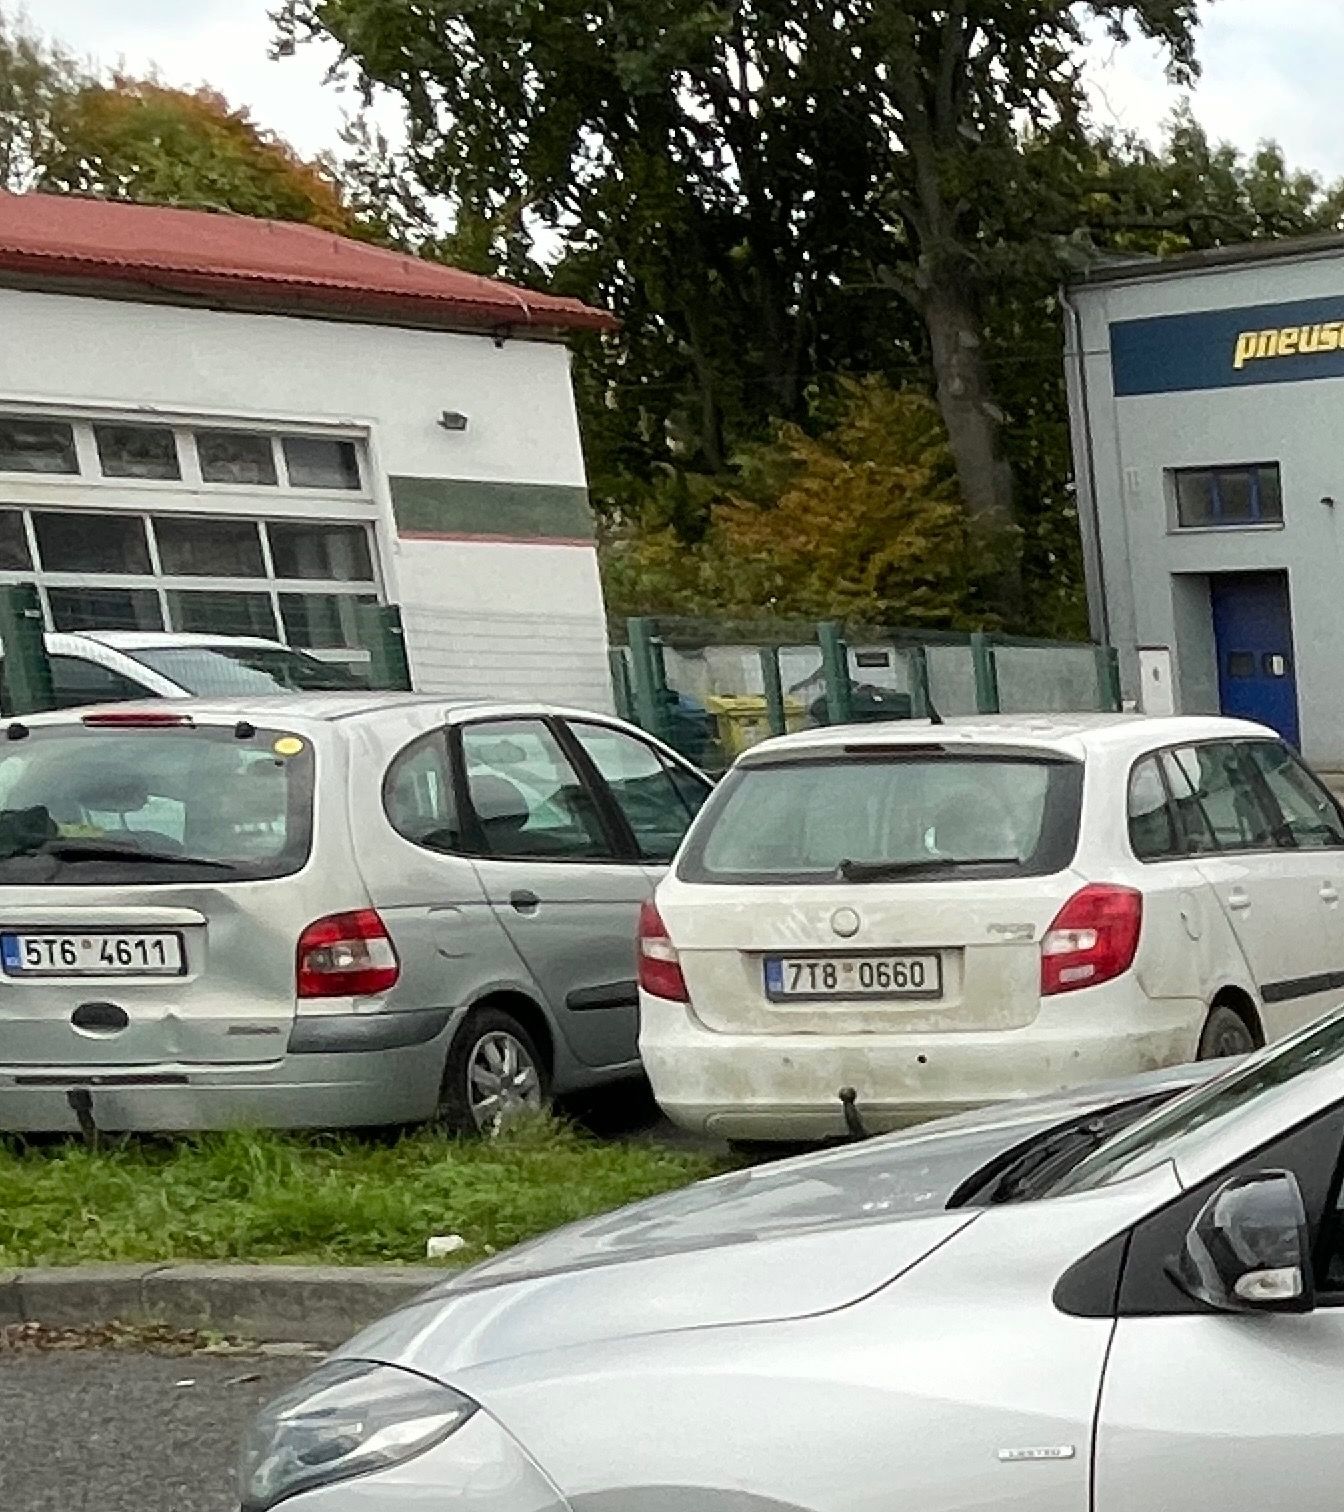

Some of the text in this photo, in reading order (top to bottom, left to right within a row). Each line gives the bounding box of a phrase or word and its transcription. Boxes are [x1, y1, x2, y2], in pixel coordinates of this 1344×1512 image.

[25, 938, 167, 966] 5T6 4611
[788, 960, 925, 991] 7T8 0660
